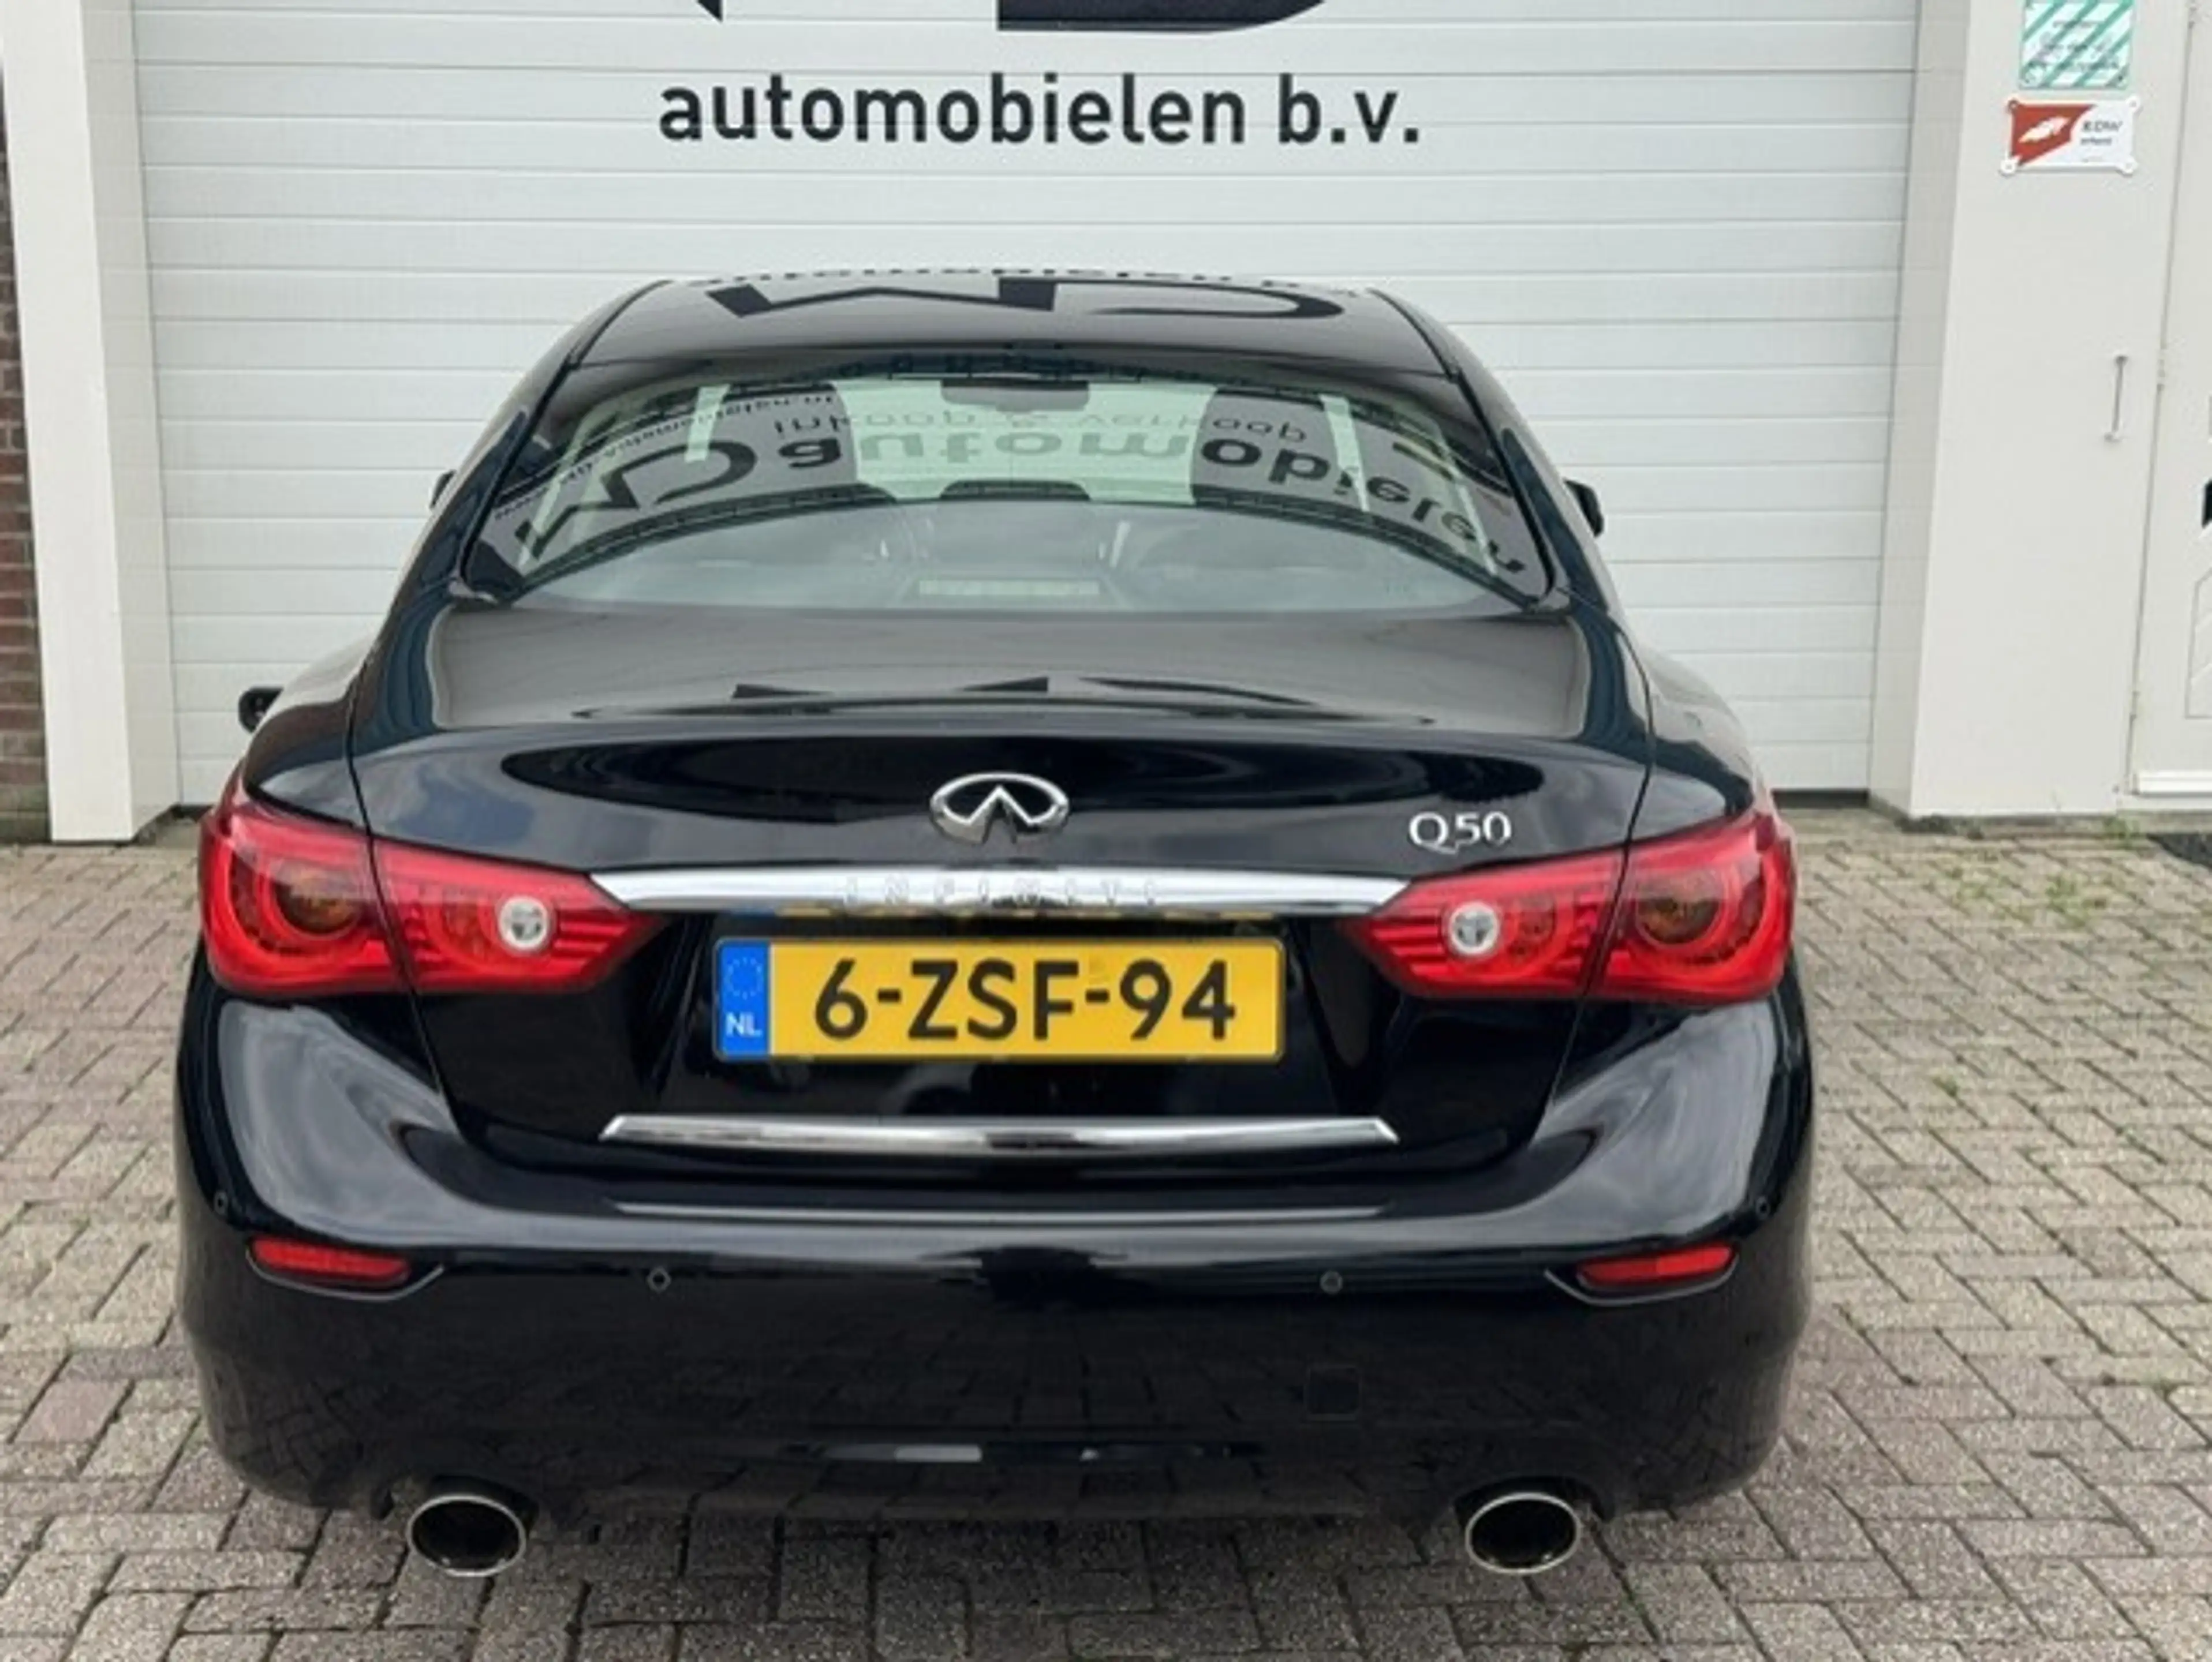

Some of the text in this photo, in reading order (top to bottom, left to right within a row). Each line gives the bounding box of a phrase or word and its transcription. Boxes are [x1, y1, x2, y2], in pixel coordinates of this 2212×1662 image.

[659, 72, 1420, 145] automobielen b.v.
[1408, 810, 1512, 855] Q50
[725, 1012, 763, 1038] NL
[814, 957, 1236, 1042] 6-ZSF-94
